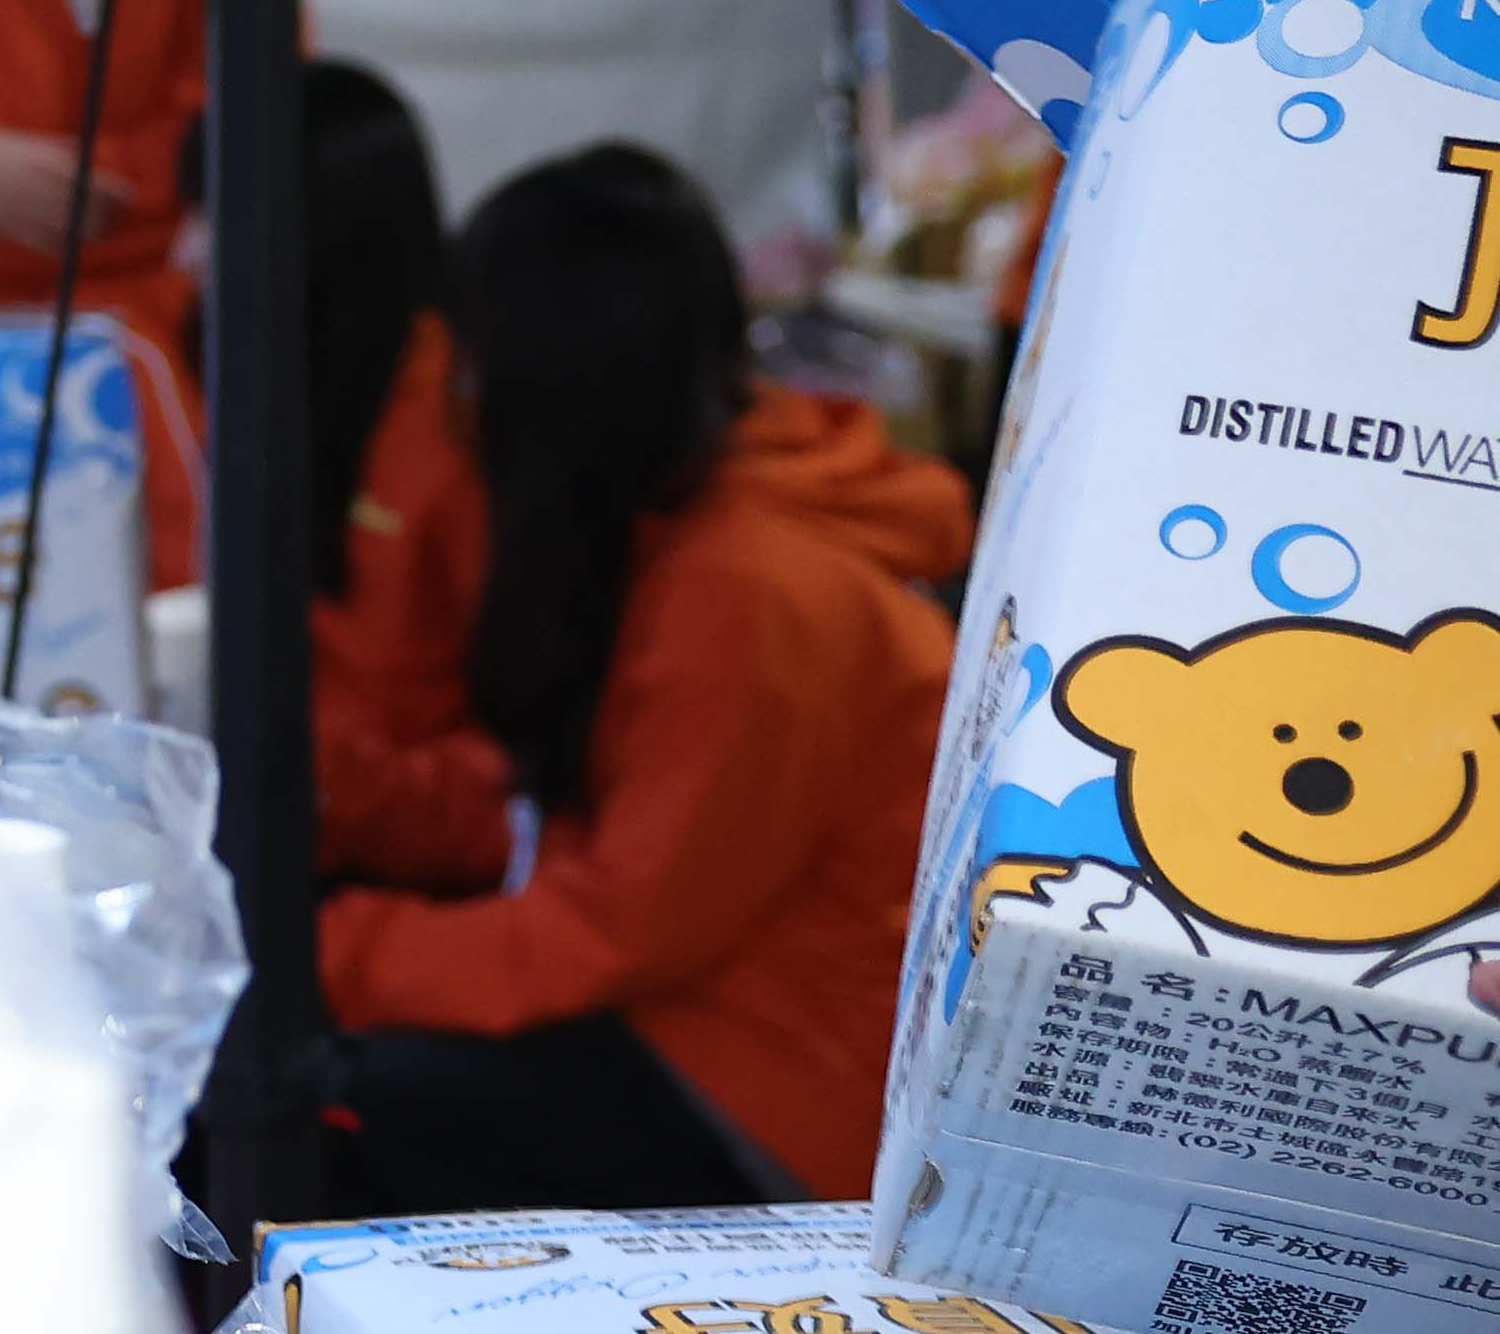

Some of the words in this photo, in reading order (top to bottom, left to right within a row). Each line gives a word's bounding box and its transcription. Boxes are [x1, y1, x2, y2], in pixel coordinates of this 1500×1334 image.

[1179, 394, 1406, 464] DISTILLED
[1411, 424, 1500, 481] WA
[1240, 988, 1500, 1065] MAXPU
[1213, 1222, 1409, 1277] 存放時
